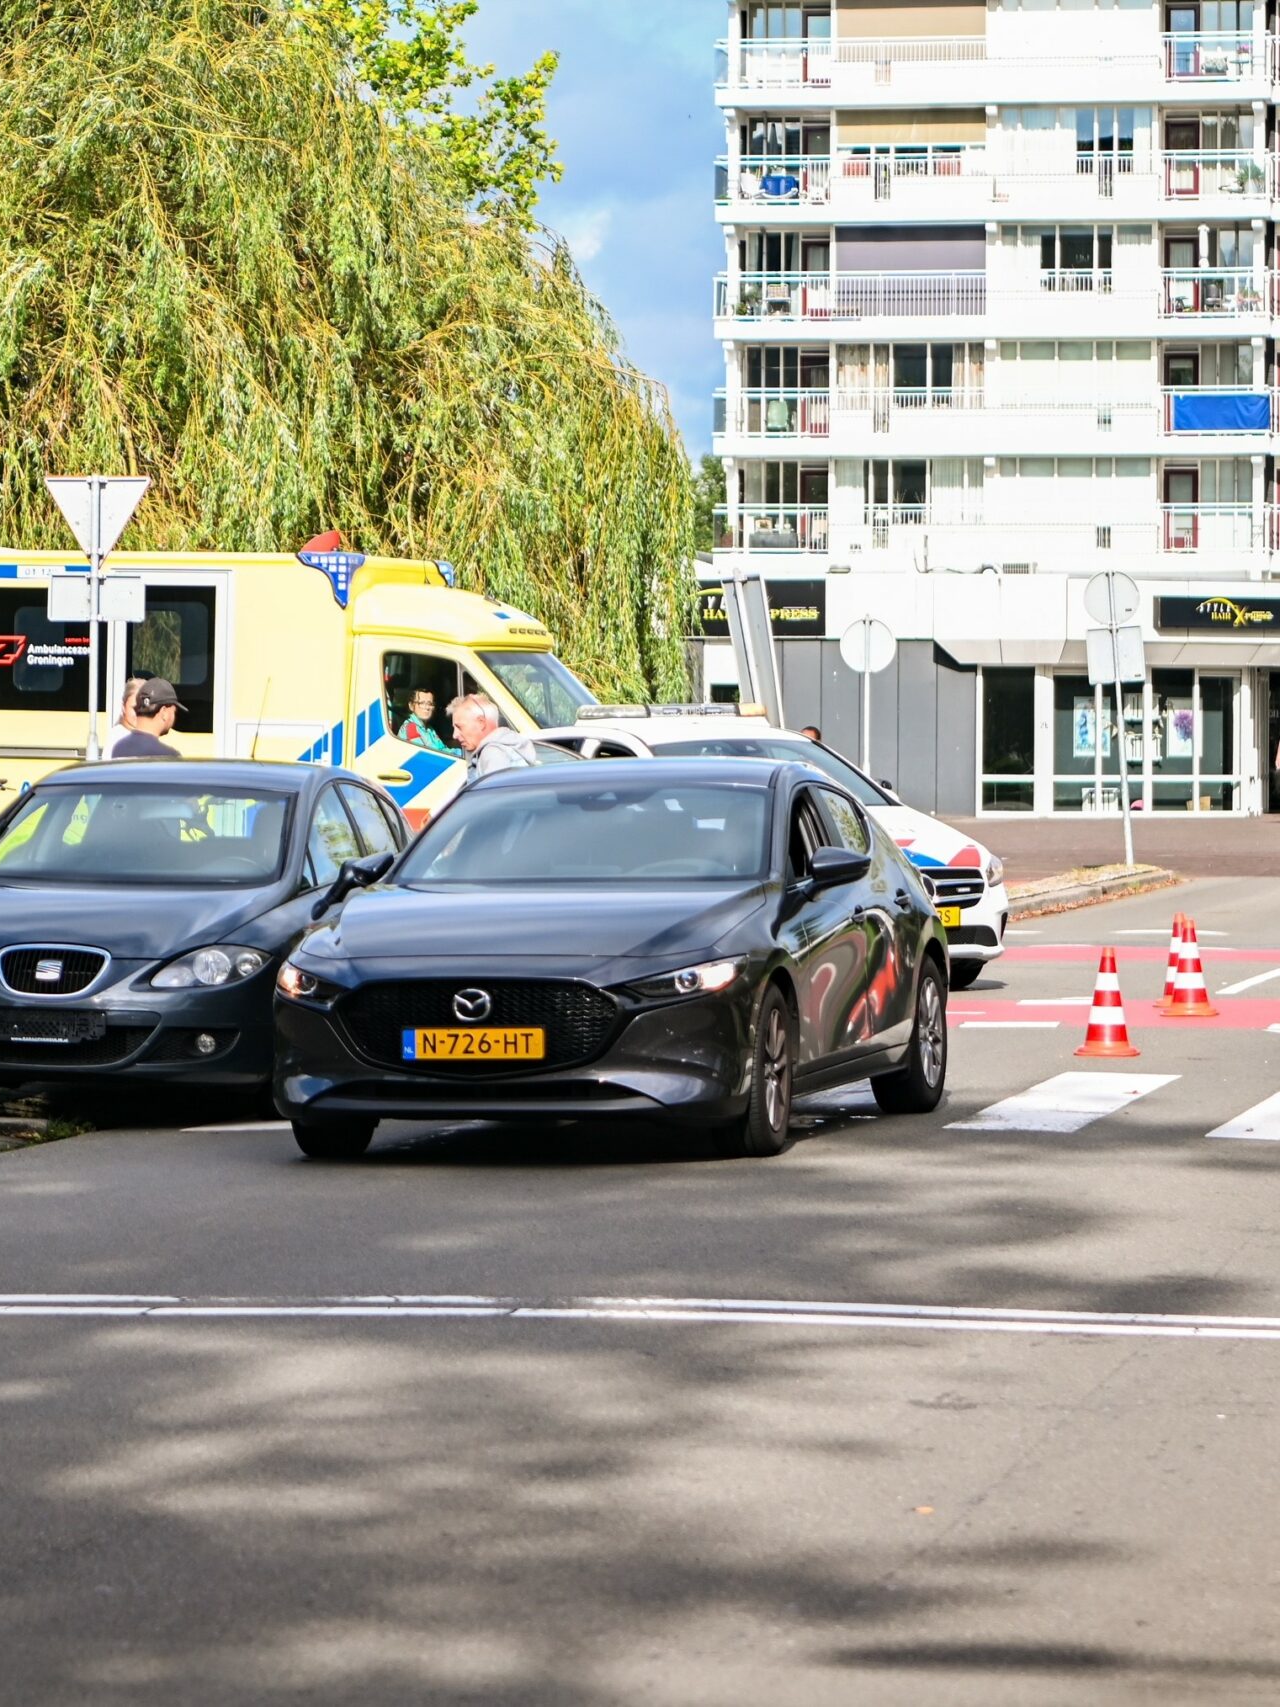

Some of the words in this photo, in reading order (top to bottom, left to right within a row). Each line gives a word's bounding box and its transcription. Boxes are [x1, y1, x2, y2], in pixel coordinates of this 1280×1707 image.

[702, 608, 728, 620] HA
[769, 608, 820, 620] PRESS
[1199, 603, 1231, 613] STYLE
[26, 654, 75, 668] Groningen
[404, 1046, 414, 1054] NL
[422, 1033, 534, 1055] N-726-HT
